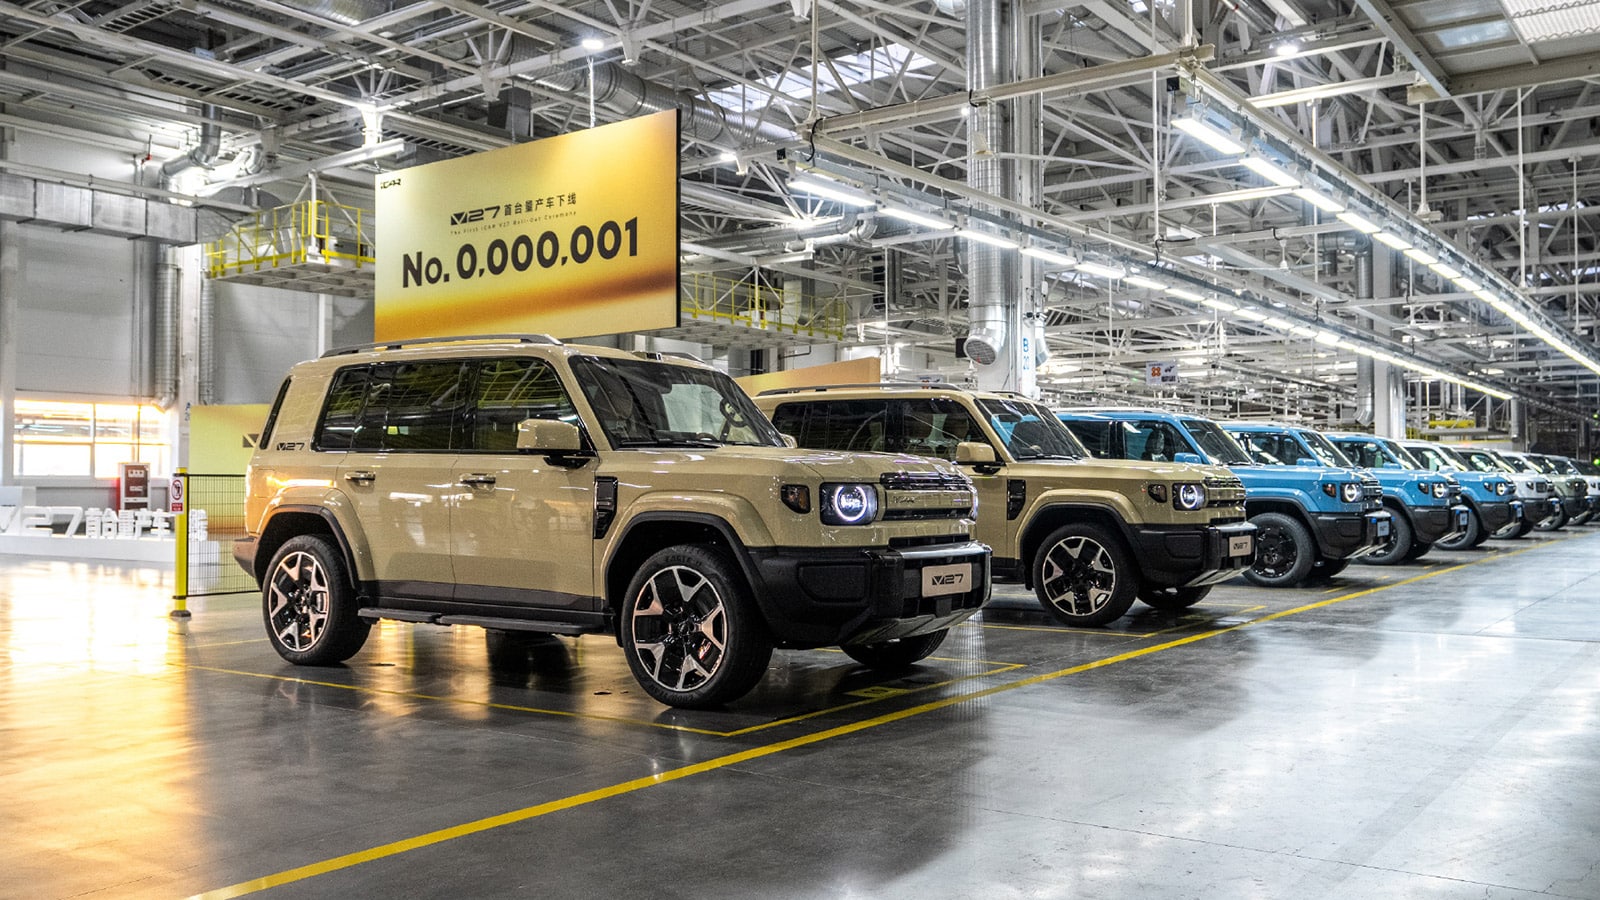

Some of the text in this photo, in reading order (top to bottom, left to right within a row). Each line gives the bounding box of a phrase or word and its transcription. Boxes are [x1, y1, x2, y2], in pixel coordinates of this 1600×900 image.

[450, 192, 577, 226] V27 首台量产车下线
[402, 216, 638, 288] No. 0,000,001
[276, 442, 305, 451] V27
[85, 508, 208, 541] 首台量产车线
[931, 573, 964, 586] V27
